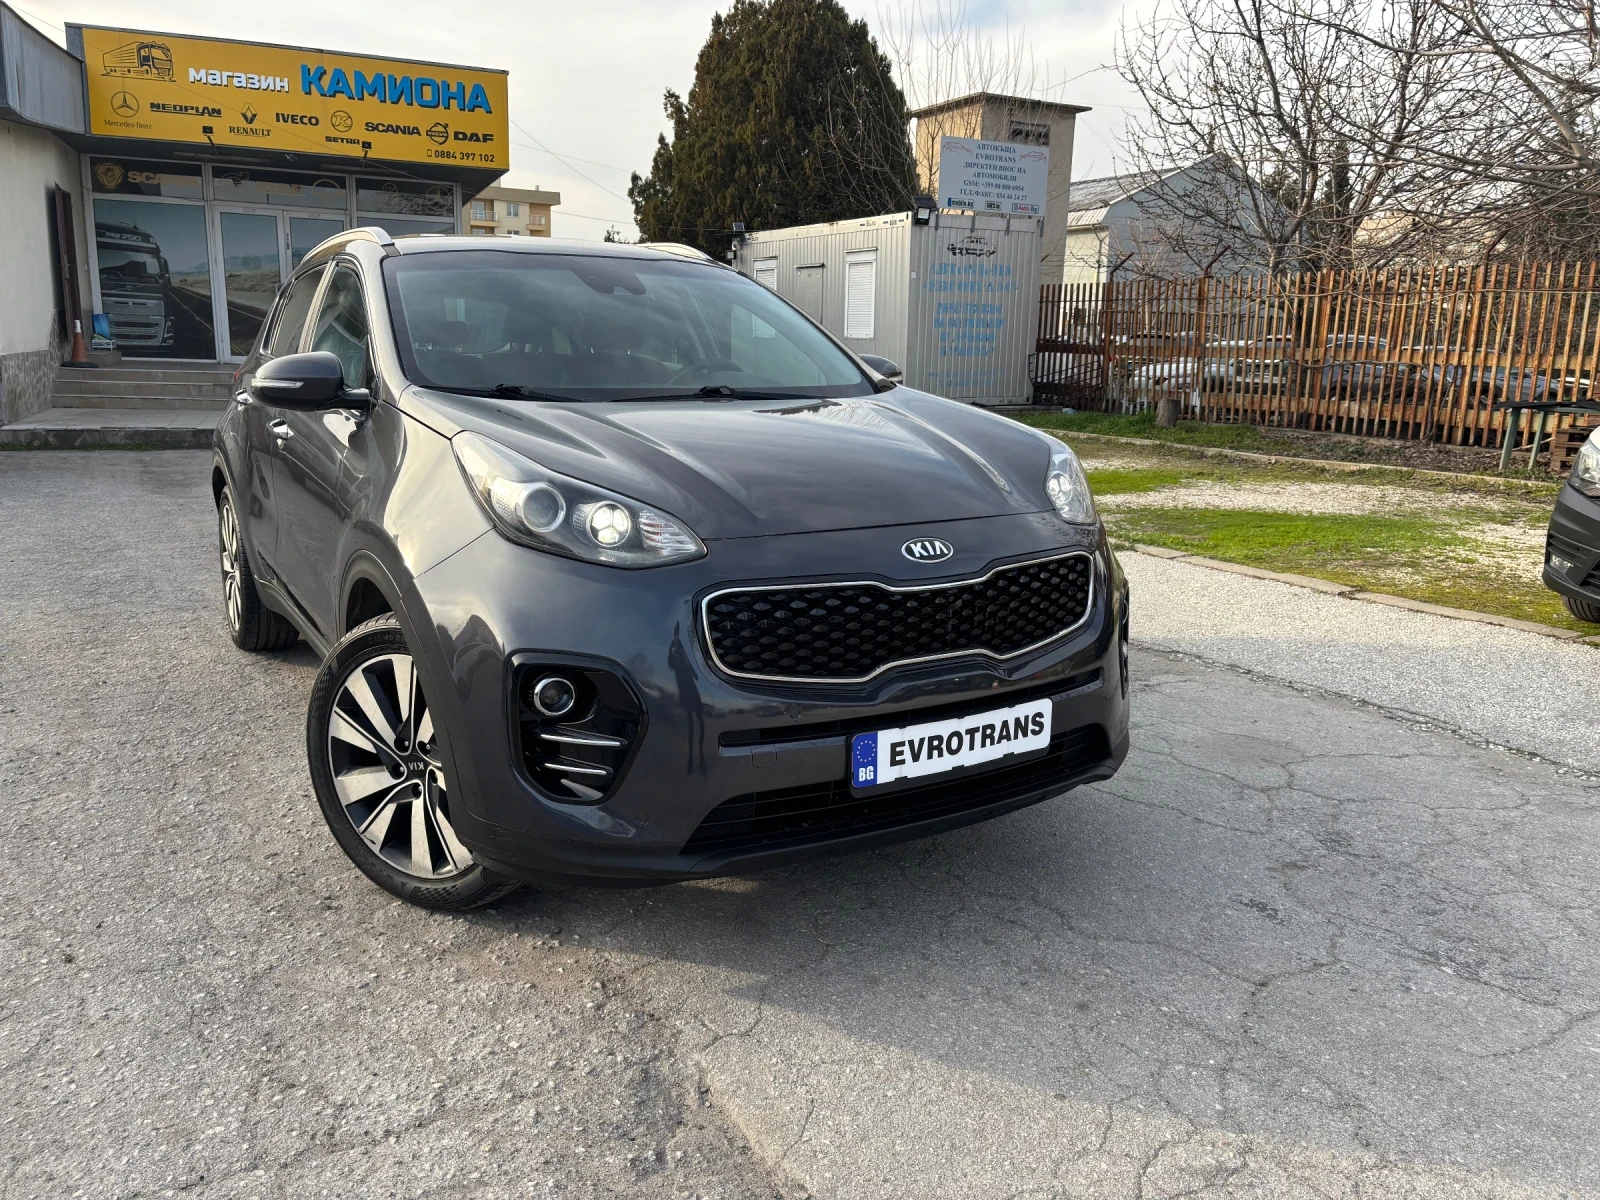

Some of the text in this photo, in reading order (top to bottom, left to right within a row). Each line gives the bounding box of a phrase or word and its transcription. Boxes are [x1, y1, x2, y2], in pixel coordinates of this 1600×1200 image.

[188, 64, 492, 113] магазин КАМИОНА
[150, 102, 222, 117] NEOPLAN
[104, 119, 152, 130] Mercedes-Benz
[275, 112, 319, 126] IVECO
[229, 125, 271, 137] RENAULT
[364, 122, 421, 136] SCANIA
[325, 135, 360, 145] SETRA
[453, 131, 494, 143] DAF
[976, 143, 1016, 154] АВТОКЪЩА
[434, 149, 495, 163] 0884 397 102
[975, 153, 1016, 163] EVROTRANS
[963, 162, 998, 171] ДИРЕКТЕН
[972, 171, 1017, 181] АВТОМОБИЛИ
[1006, 192, 1013, 200] 44
[908, 540, 949, 558] KIA
[889, 711, 1045, 768] EVROTRANS
[408, 761, 425, 771] KIA
[858, 766, 874, 782] BG
